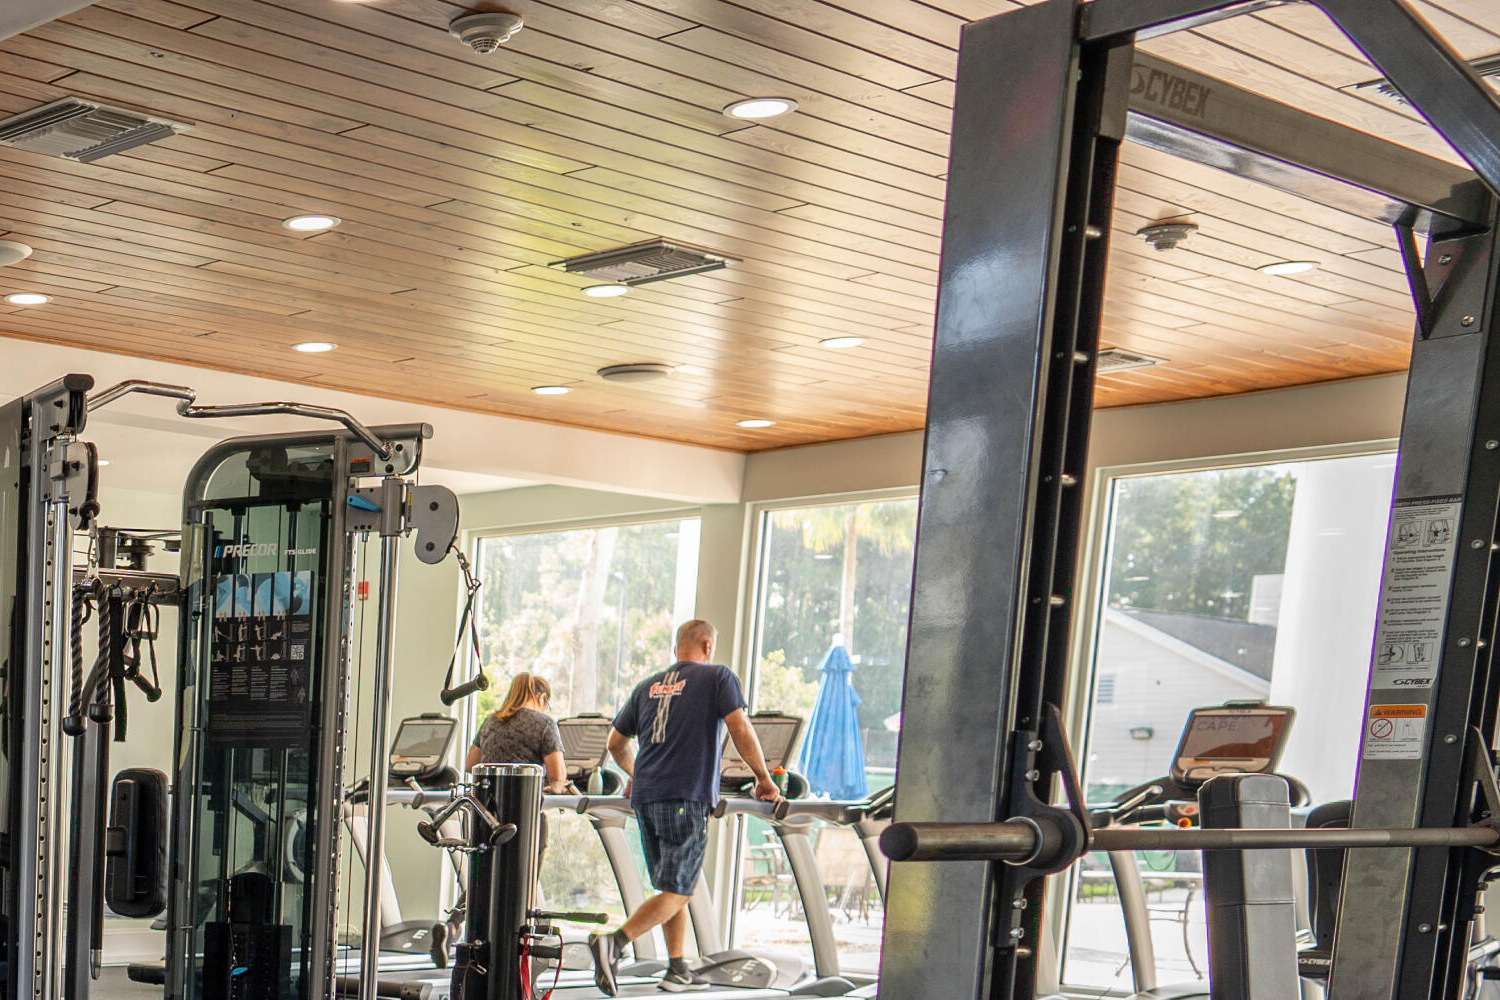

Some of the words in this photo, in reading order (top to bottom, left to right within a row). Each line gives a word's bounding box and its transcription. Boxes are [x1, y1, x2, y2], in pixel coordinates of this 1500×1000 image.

[1144, 69, 1212, 119] CYBEX
[222, 543, 278, 558] PRECOR
[283, 548, 296, 556] FTS
[297, 547, 317, 555] GLIDE
